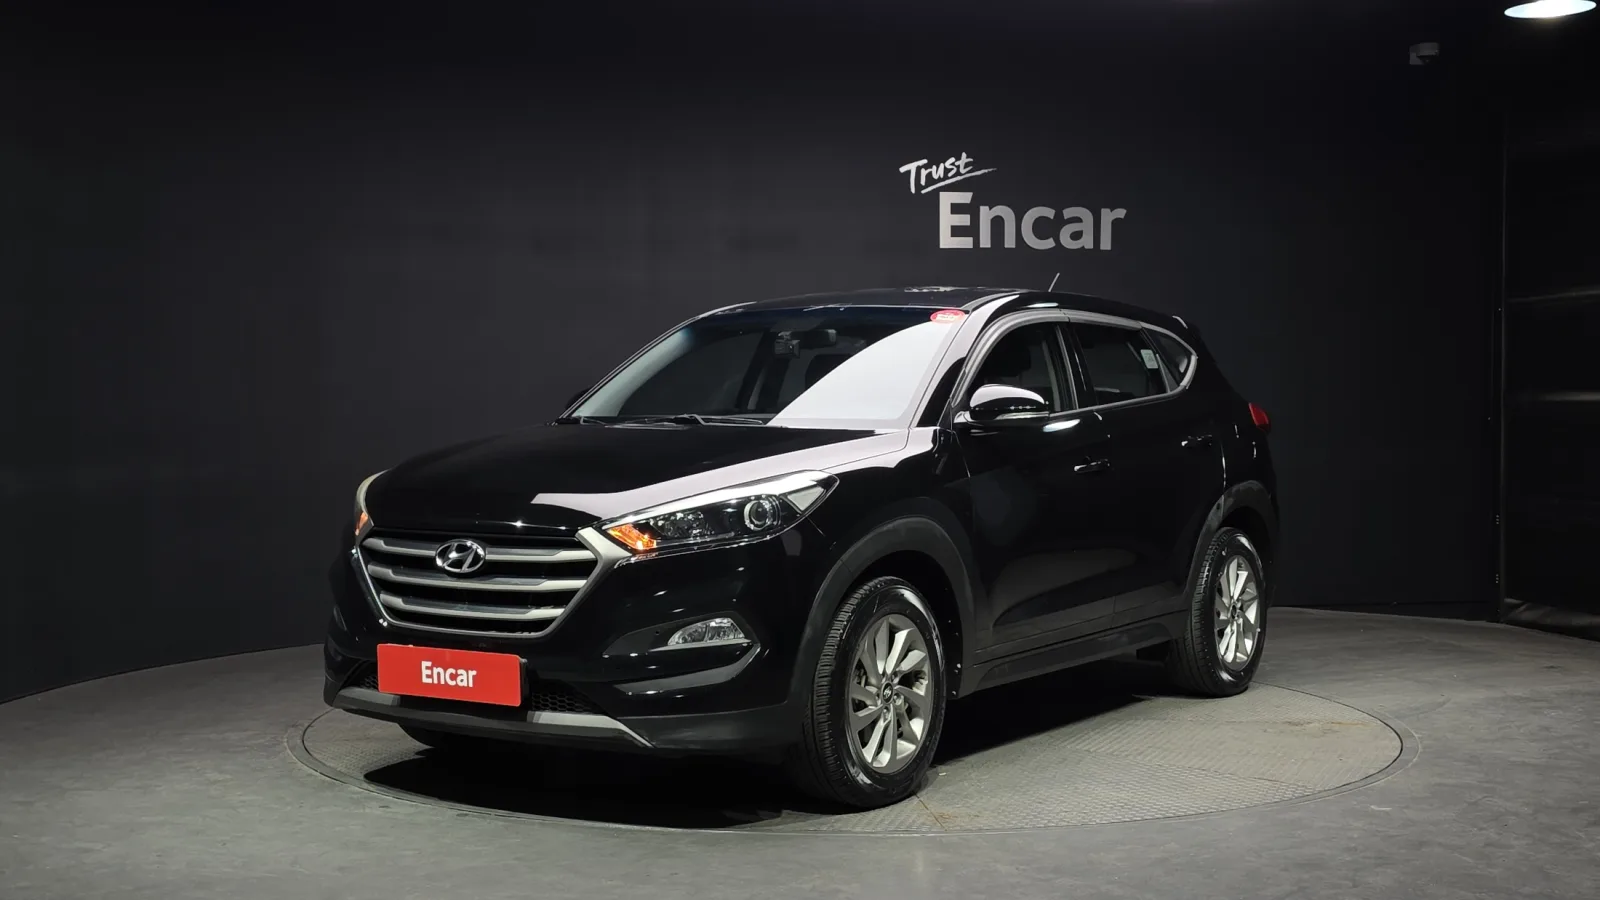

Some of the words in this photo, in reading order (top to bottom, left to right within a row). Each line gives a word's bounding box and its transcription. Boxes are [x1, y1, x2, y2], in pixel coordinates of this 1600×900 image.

[899, 152, 974, 194] Trust
[939, 191, 1127, 250] Encar
[421, 661, 477, 687] Encar
